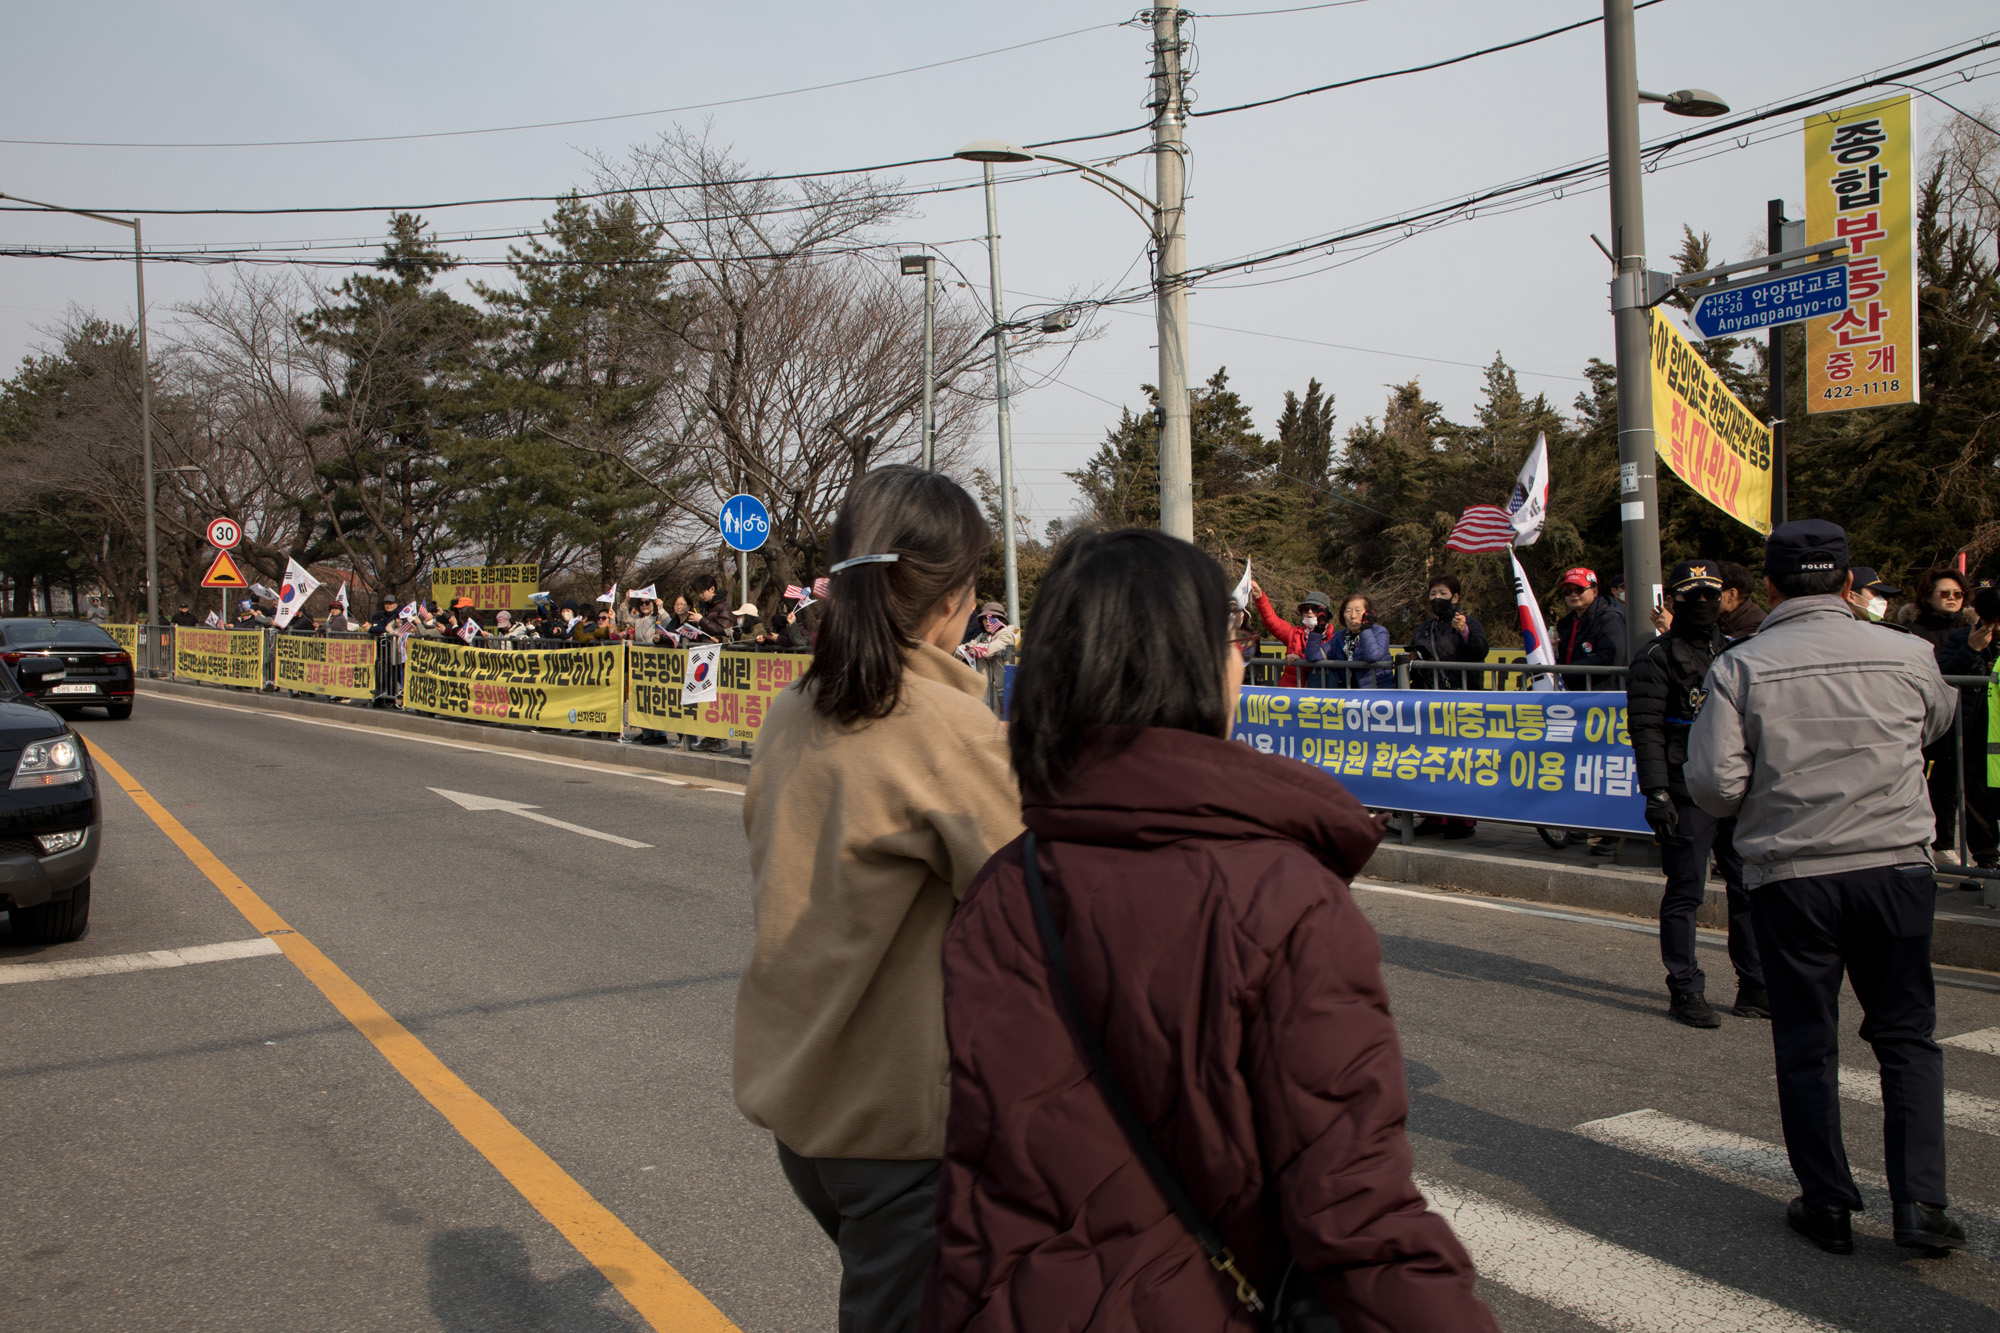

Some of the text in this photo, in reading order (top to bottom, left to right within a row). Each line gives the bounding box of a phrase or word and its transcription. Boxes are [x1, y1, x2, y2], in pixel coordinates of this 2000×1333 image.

[1831, 119, 1888, 347] 종합부동산
[1713, 291, 1743, 305] 145-2
[1752, 272, 1842, 308] 안양판교로
[1706, 302, 1743, 318] 145-20
[1718, 295, 1842, 331] Anyangpangyo-ro
[1667, 333, 1709, 420] 합의없는
[1709, 380, 1752, 460] 헌법재판관
[1750, 425, 1770, 471] 임명
[1823, 379, 1900, 401] 422-1118
[216, 526, 234, 541] 30
[450, 568, 478, 585] 합의없는
[480, 566, 519, 584] 헌법재판관
[521, 566, 537, 583] 임명
[278, 638, 301, 659] 민주당의
[328, 642, 343, 663] 탄핵
[410, 642, 615, 686] 헌법재판소 왜 편파적으로 재판하나?
[279, 659, 304, 682] 대한민국
[338, 666, 370, 688] 폭망한다
[630, 651, 685, 684] 민주당의
[757, 658, 792, 692] 탄핵
[473, 682, 547, 720] 홍위병인가?
[635, 685, 698, 720] 대한민국
[1246, 694, 1292, 728] 매우
[1297, 697, 1422, 735] 혼잡하오니
[1428, 702, 1577, 743] 대중교통을
[1302, 737, 1368, 776] 인덕원
[1372, 742, 1501, 786] 환승주차장
[1510, 751, 1565, 792] 이용
